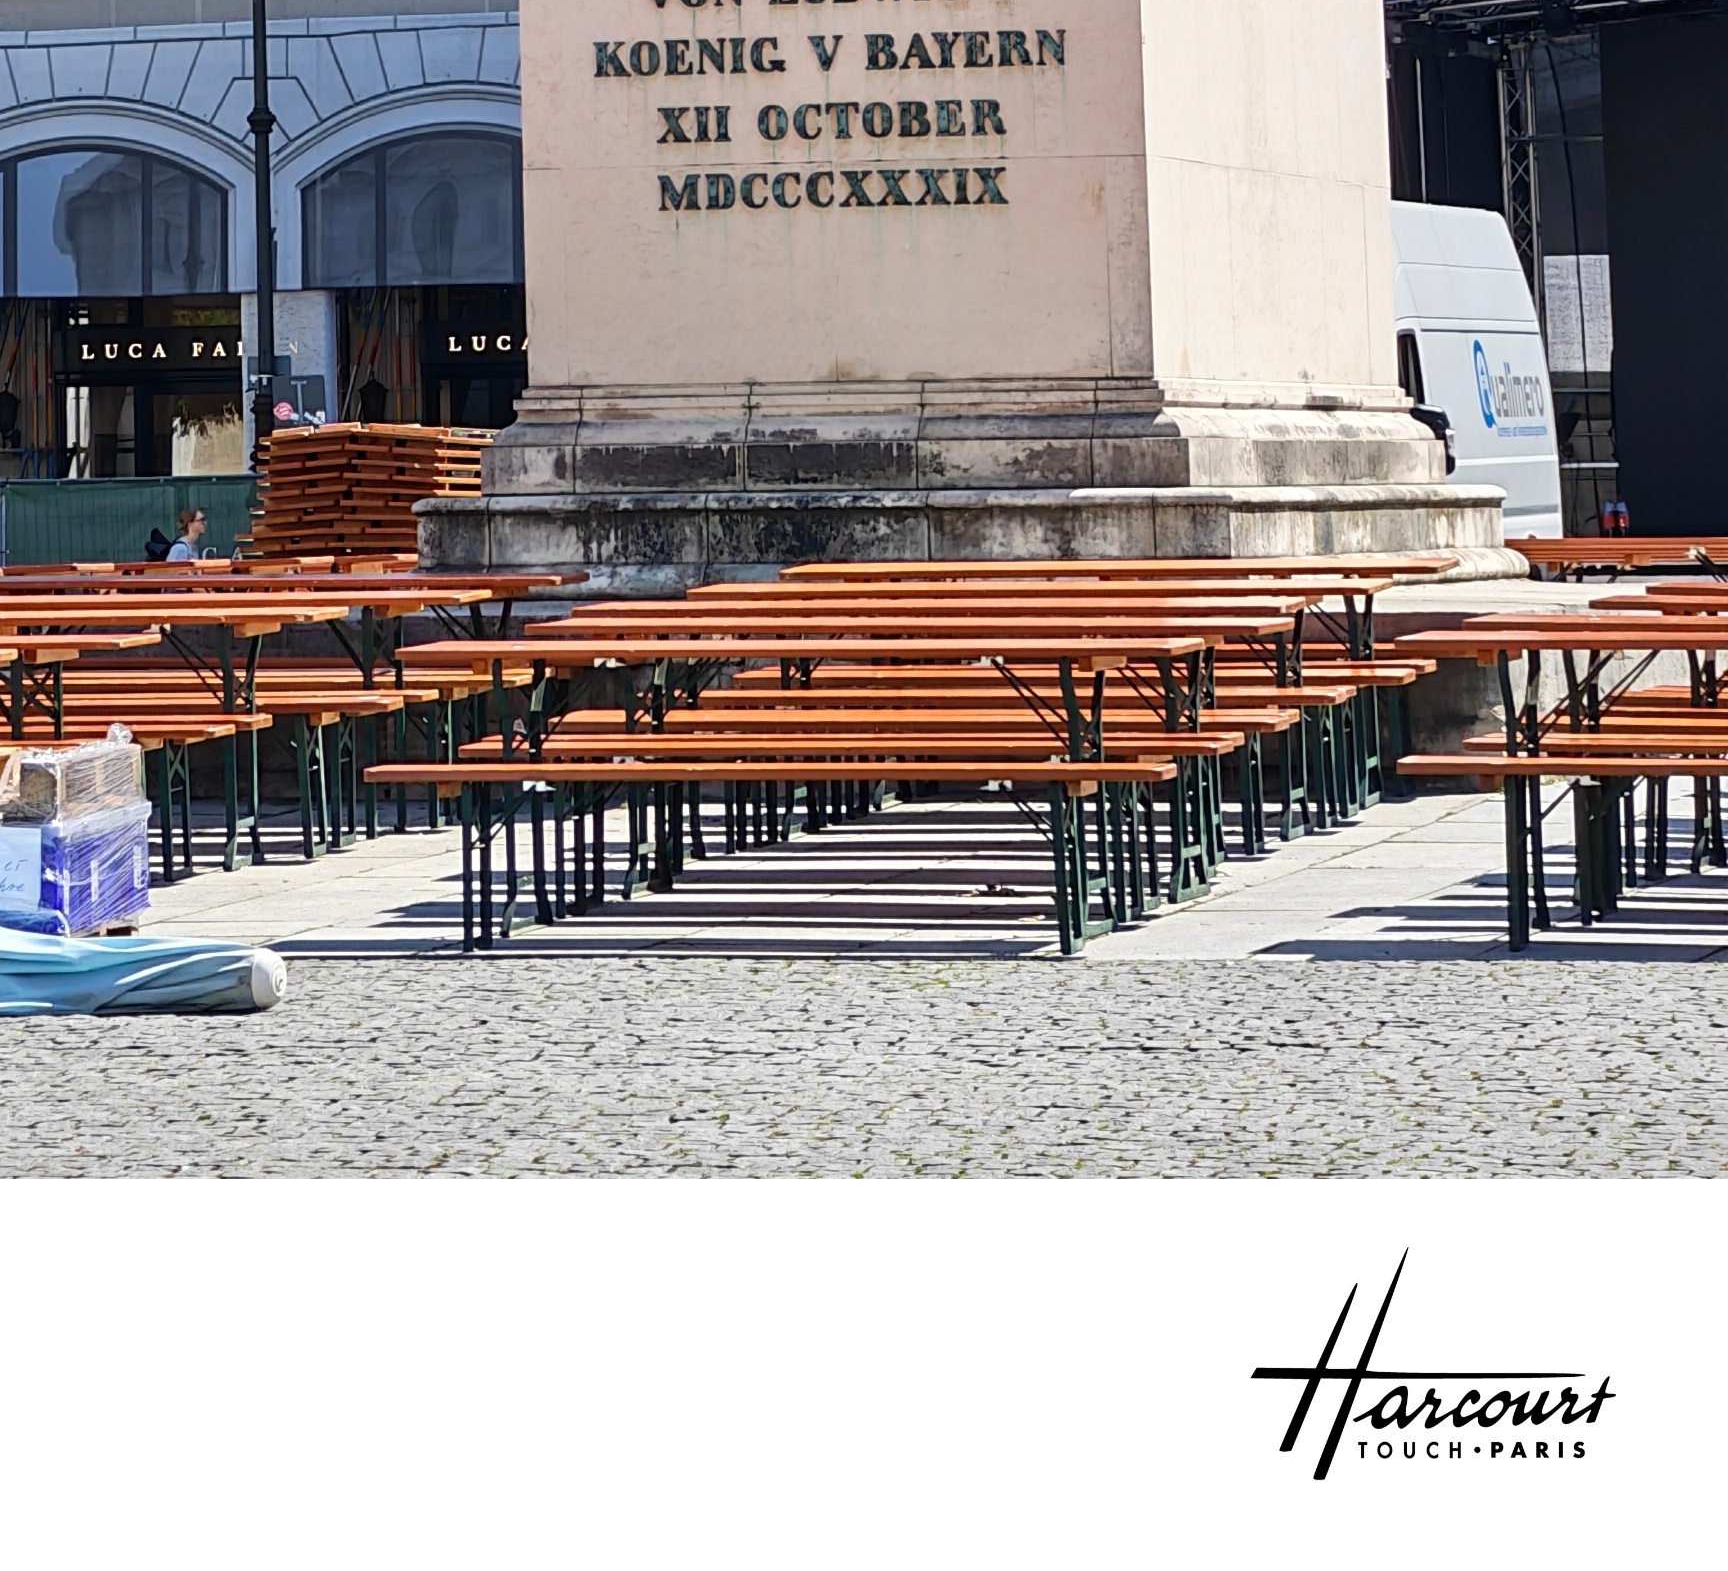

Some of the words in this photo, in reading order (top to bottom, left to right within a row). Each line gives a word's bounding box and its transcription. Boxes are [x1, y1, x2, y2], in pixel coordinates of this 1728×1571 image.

[592, 35, 786, 78] KOENIG
[807, 34, 843, 72] V
[864, 28, 1067, 73] BAYERN
[656, 105, 732, 144] XII
[757, 98, 1007, 143] OCTOBER
[658, 166, 1009, 212] MDCCCXXXIX
[81, 343, 167, 360] LUCA
[1473, 339, 1544, 428] Qualimero
